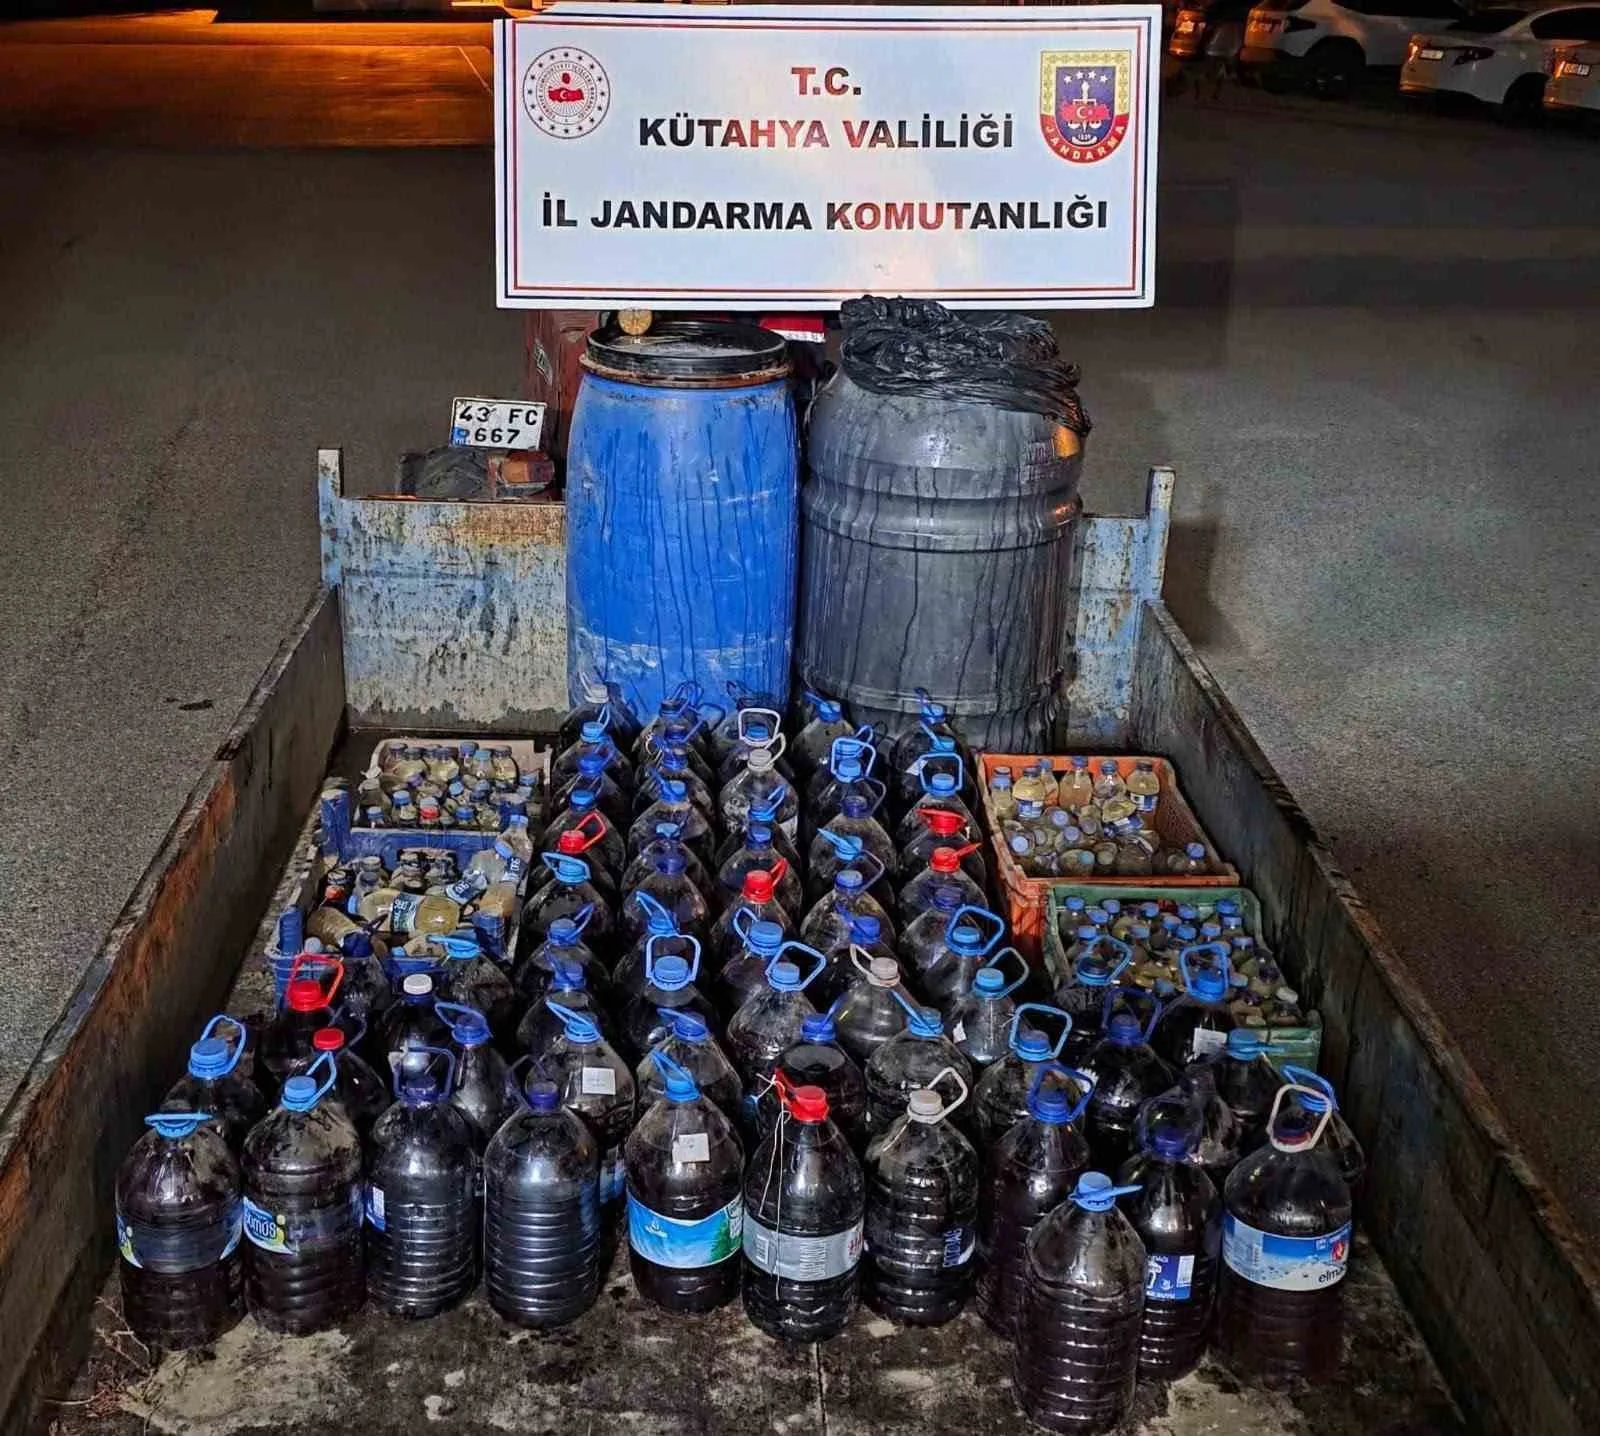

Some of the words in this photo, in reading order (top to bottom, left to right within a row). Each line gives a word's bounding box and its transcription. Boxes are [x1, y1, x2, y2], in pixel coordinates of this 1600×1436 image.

[790, 66, 862, 97] T.C.
[639, 111, 830, 149] KÜTAHYA
[841, 112, 1013, 149] VALİLİĞİ
[1045, 125, 1125, 160] JANDARMA
[542, 191, 579, 229] İL
[590, 199, 813, 231] JANDARMA
[826, 193, 1108, 231] KOMUTANLIĞI
[459, 405, 491, 423] 43
[508, 408, 538, 426] FC
[474, 427, 521, 445] 667
